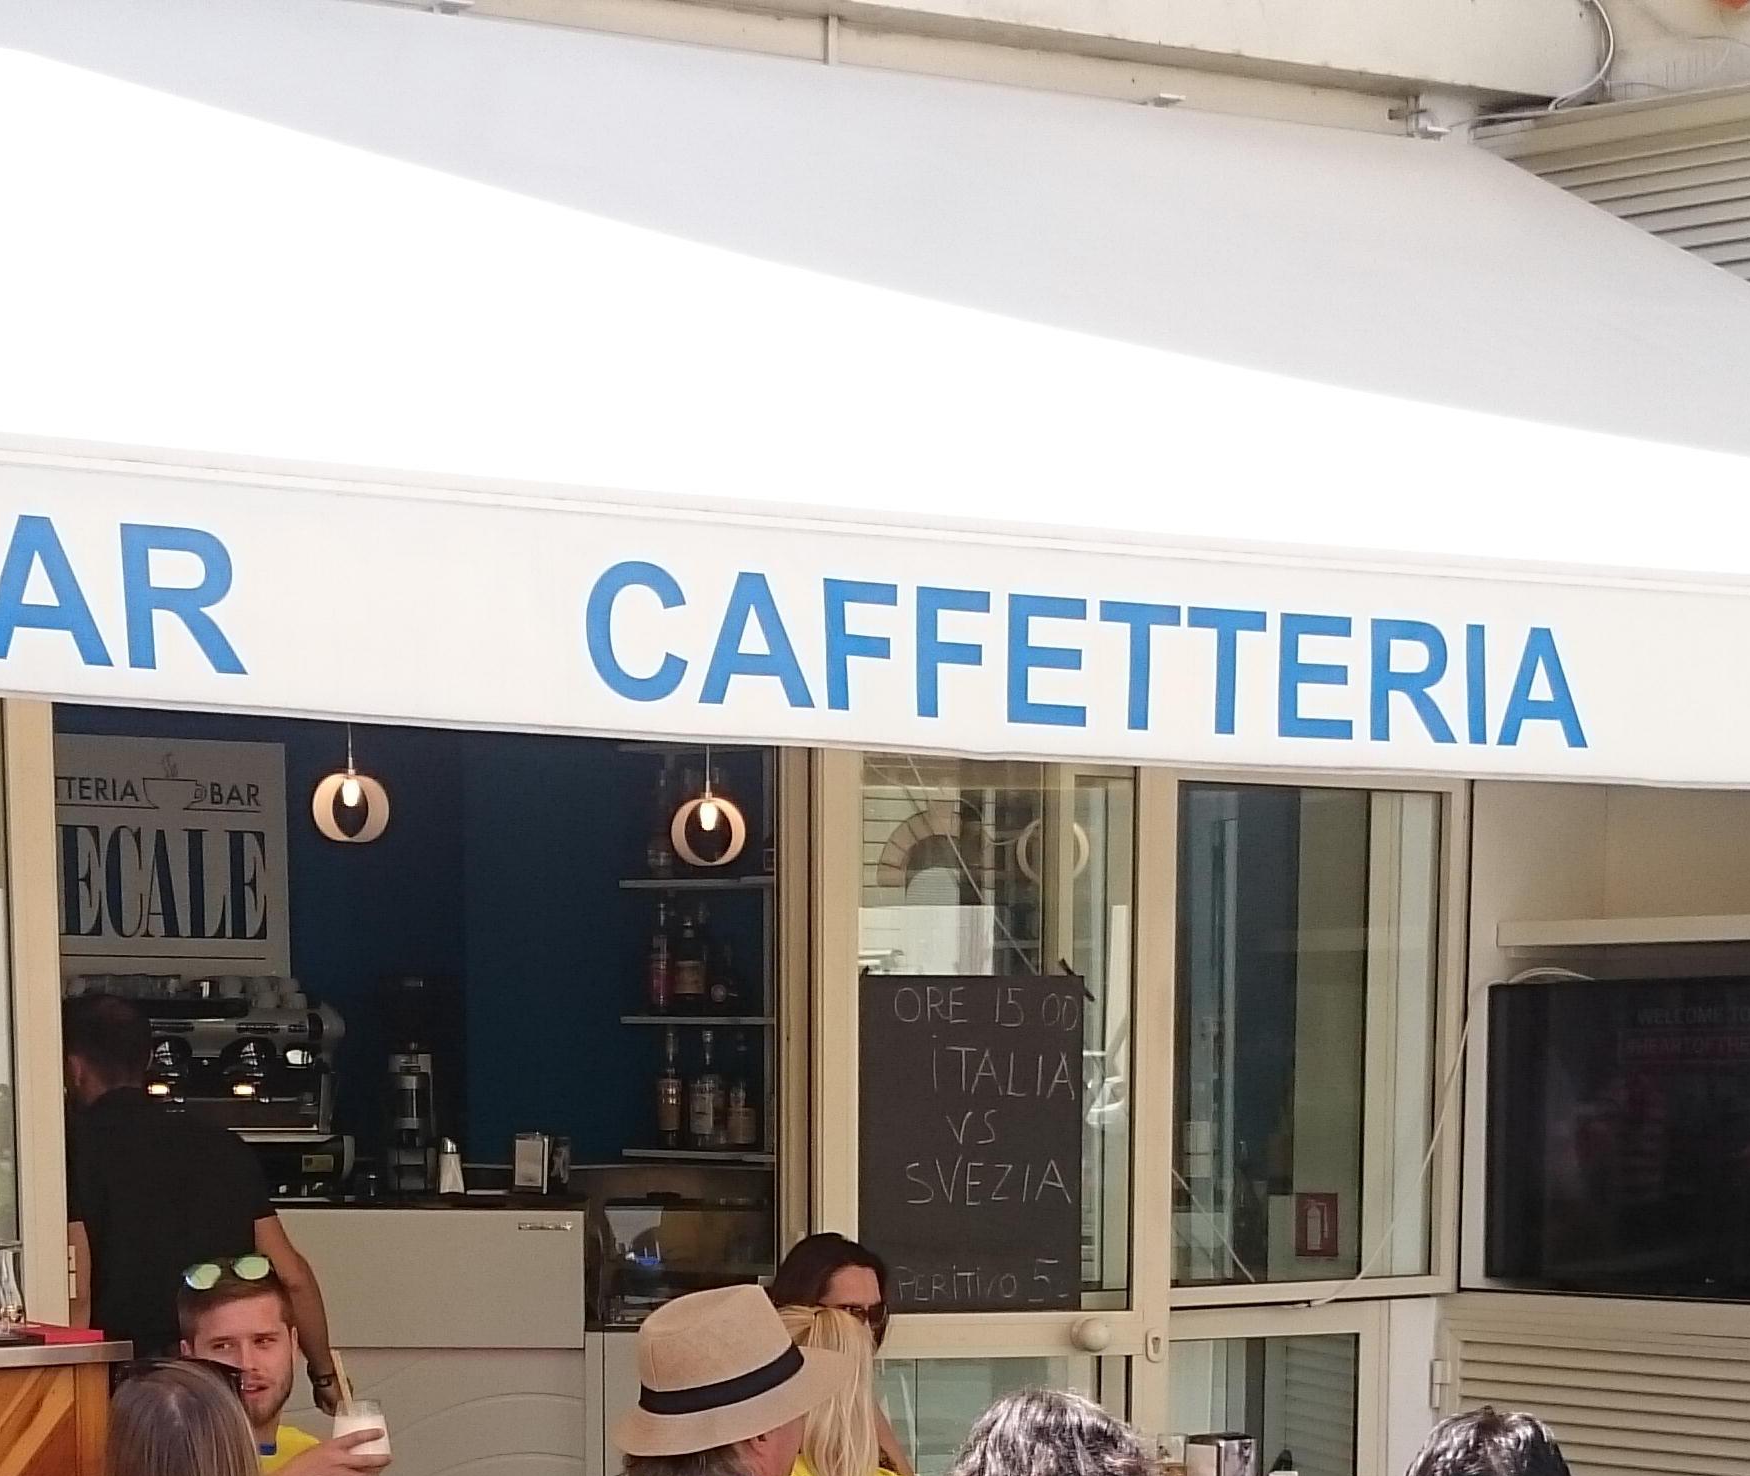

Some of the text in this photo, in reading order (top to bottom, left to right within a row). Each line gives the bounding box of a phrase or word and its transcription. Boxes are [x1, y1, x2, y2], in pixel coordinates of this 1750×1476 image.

[584, 560, 1588, 750] CAFFETTERIA
[211, 782, 262, 807] BAR
[893, 985, 970, 1024] ORE
[904, 1153, 1072, 1206] SVEZIA
